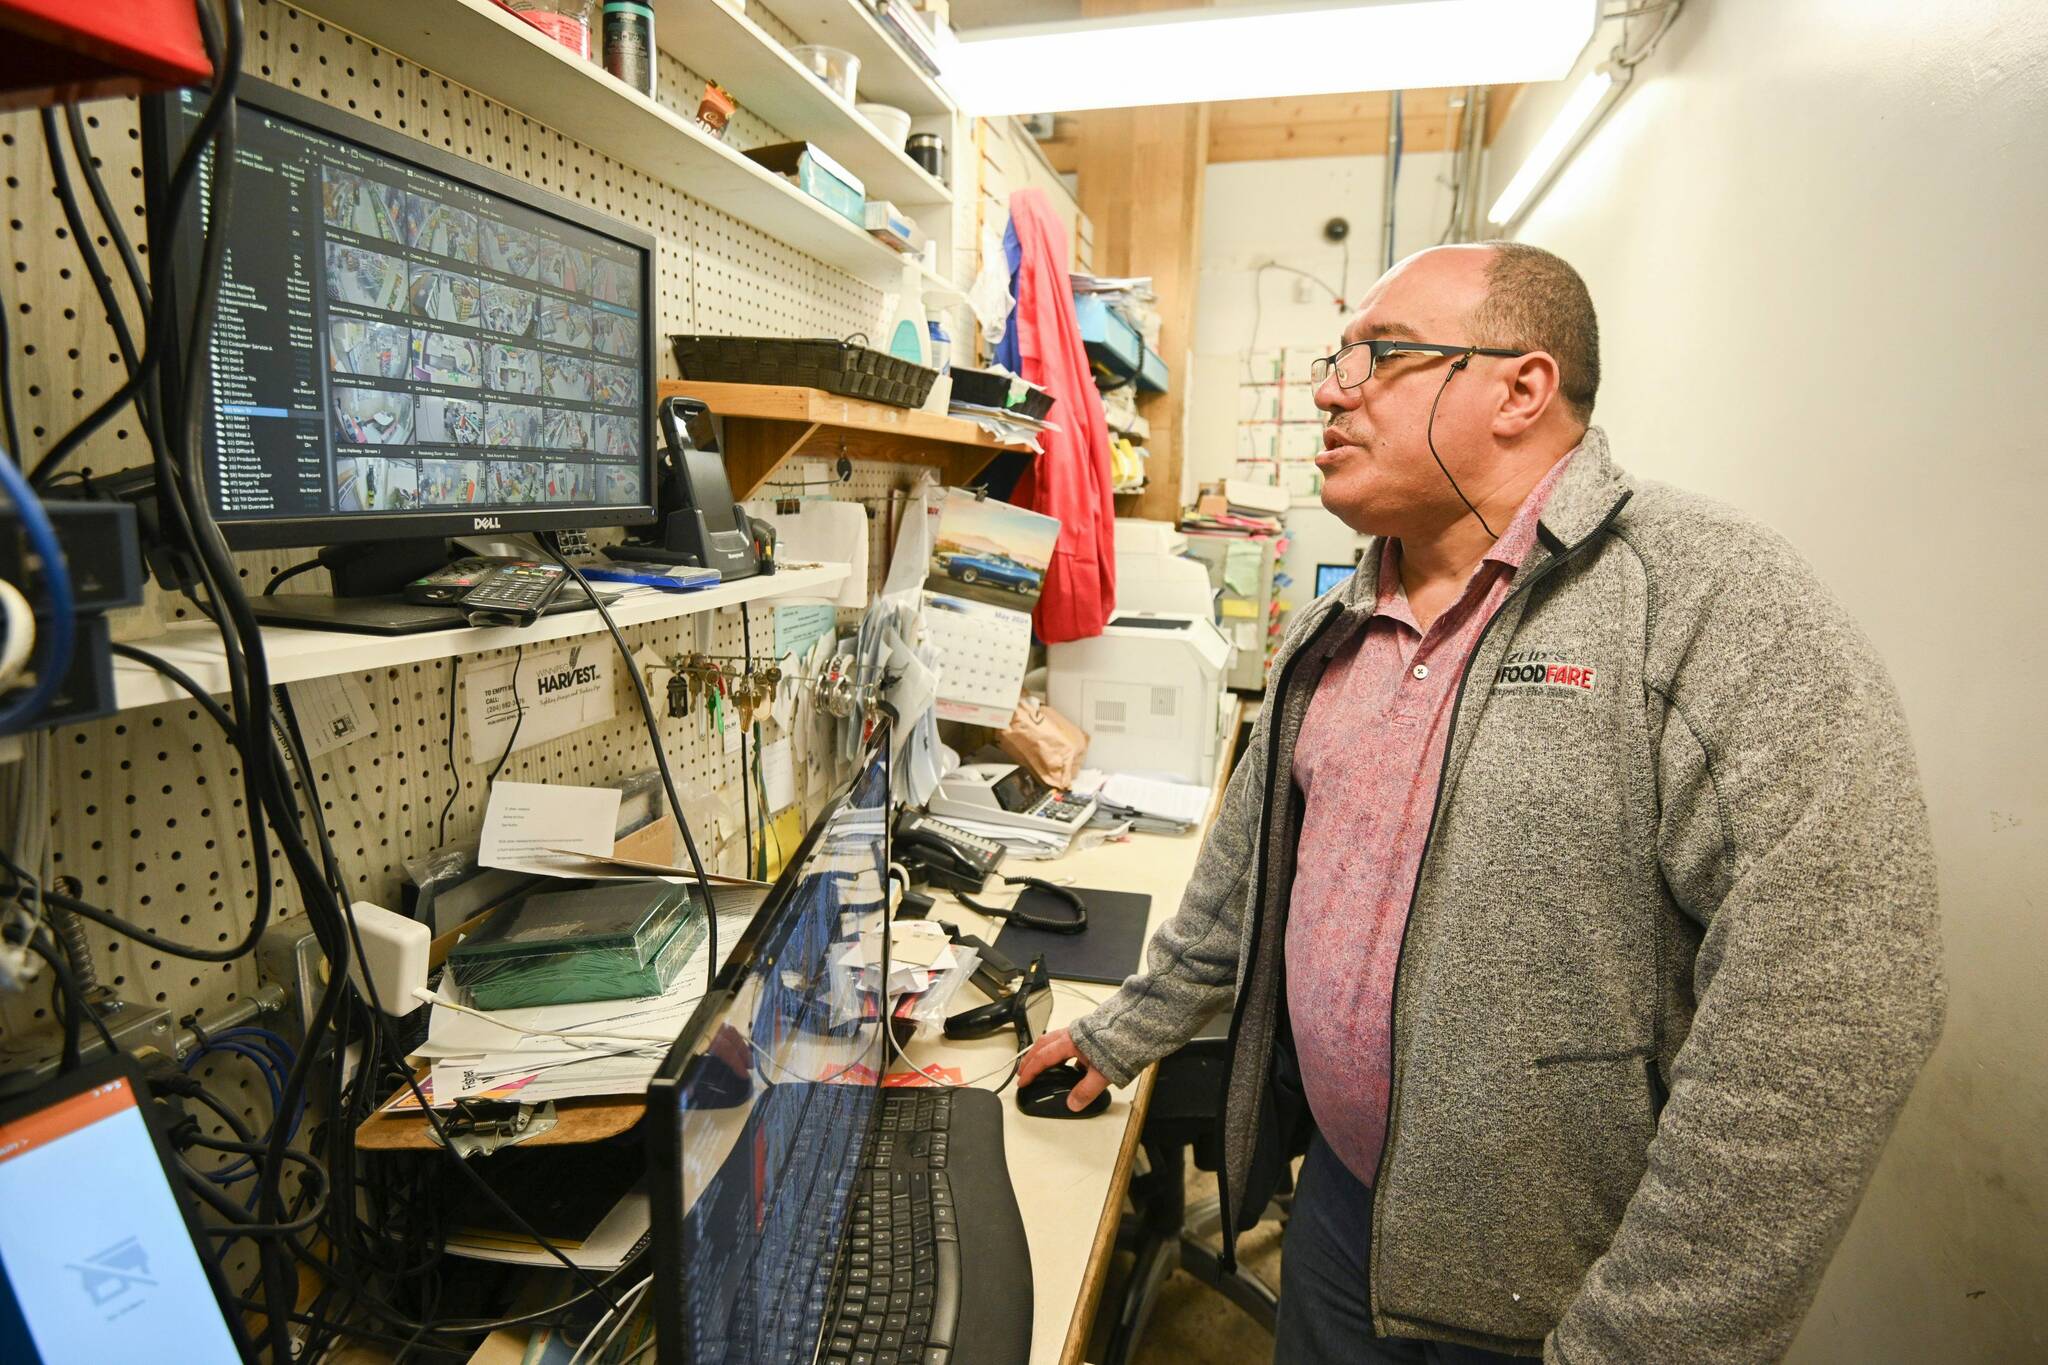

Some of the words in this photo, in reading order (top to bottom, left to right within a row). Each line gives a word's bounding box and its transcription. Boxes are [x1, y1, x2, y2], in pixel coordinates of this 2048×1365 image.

[474, 517, 501, 530] DELL
[536, 664, 568, 677] WINNIPEG
[1500, 664, 1594, 689] FOODFARE
[538, 664, 596, 695] HARVEST
[485, 688, 491, 696] TO
[492, 686, 508, 694] EMPTY
